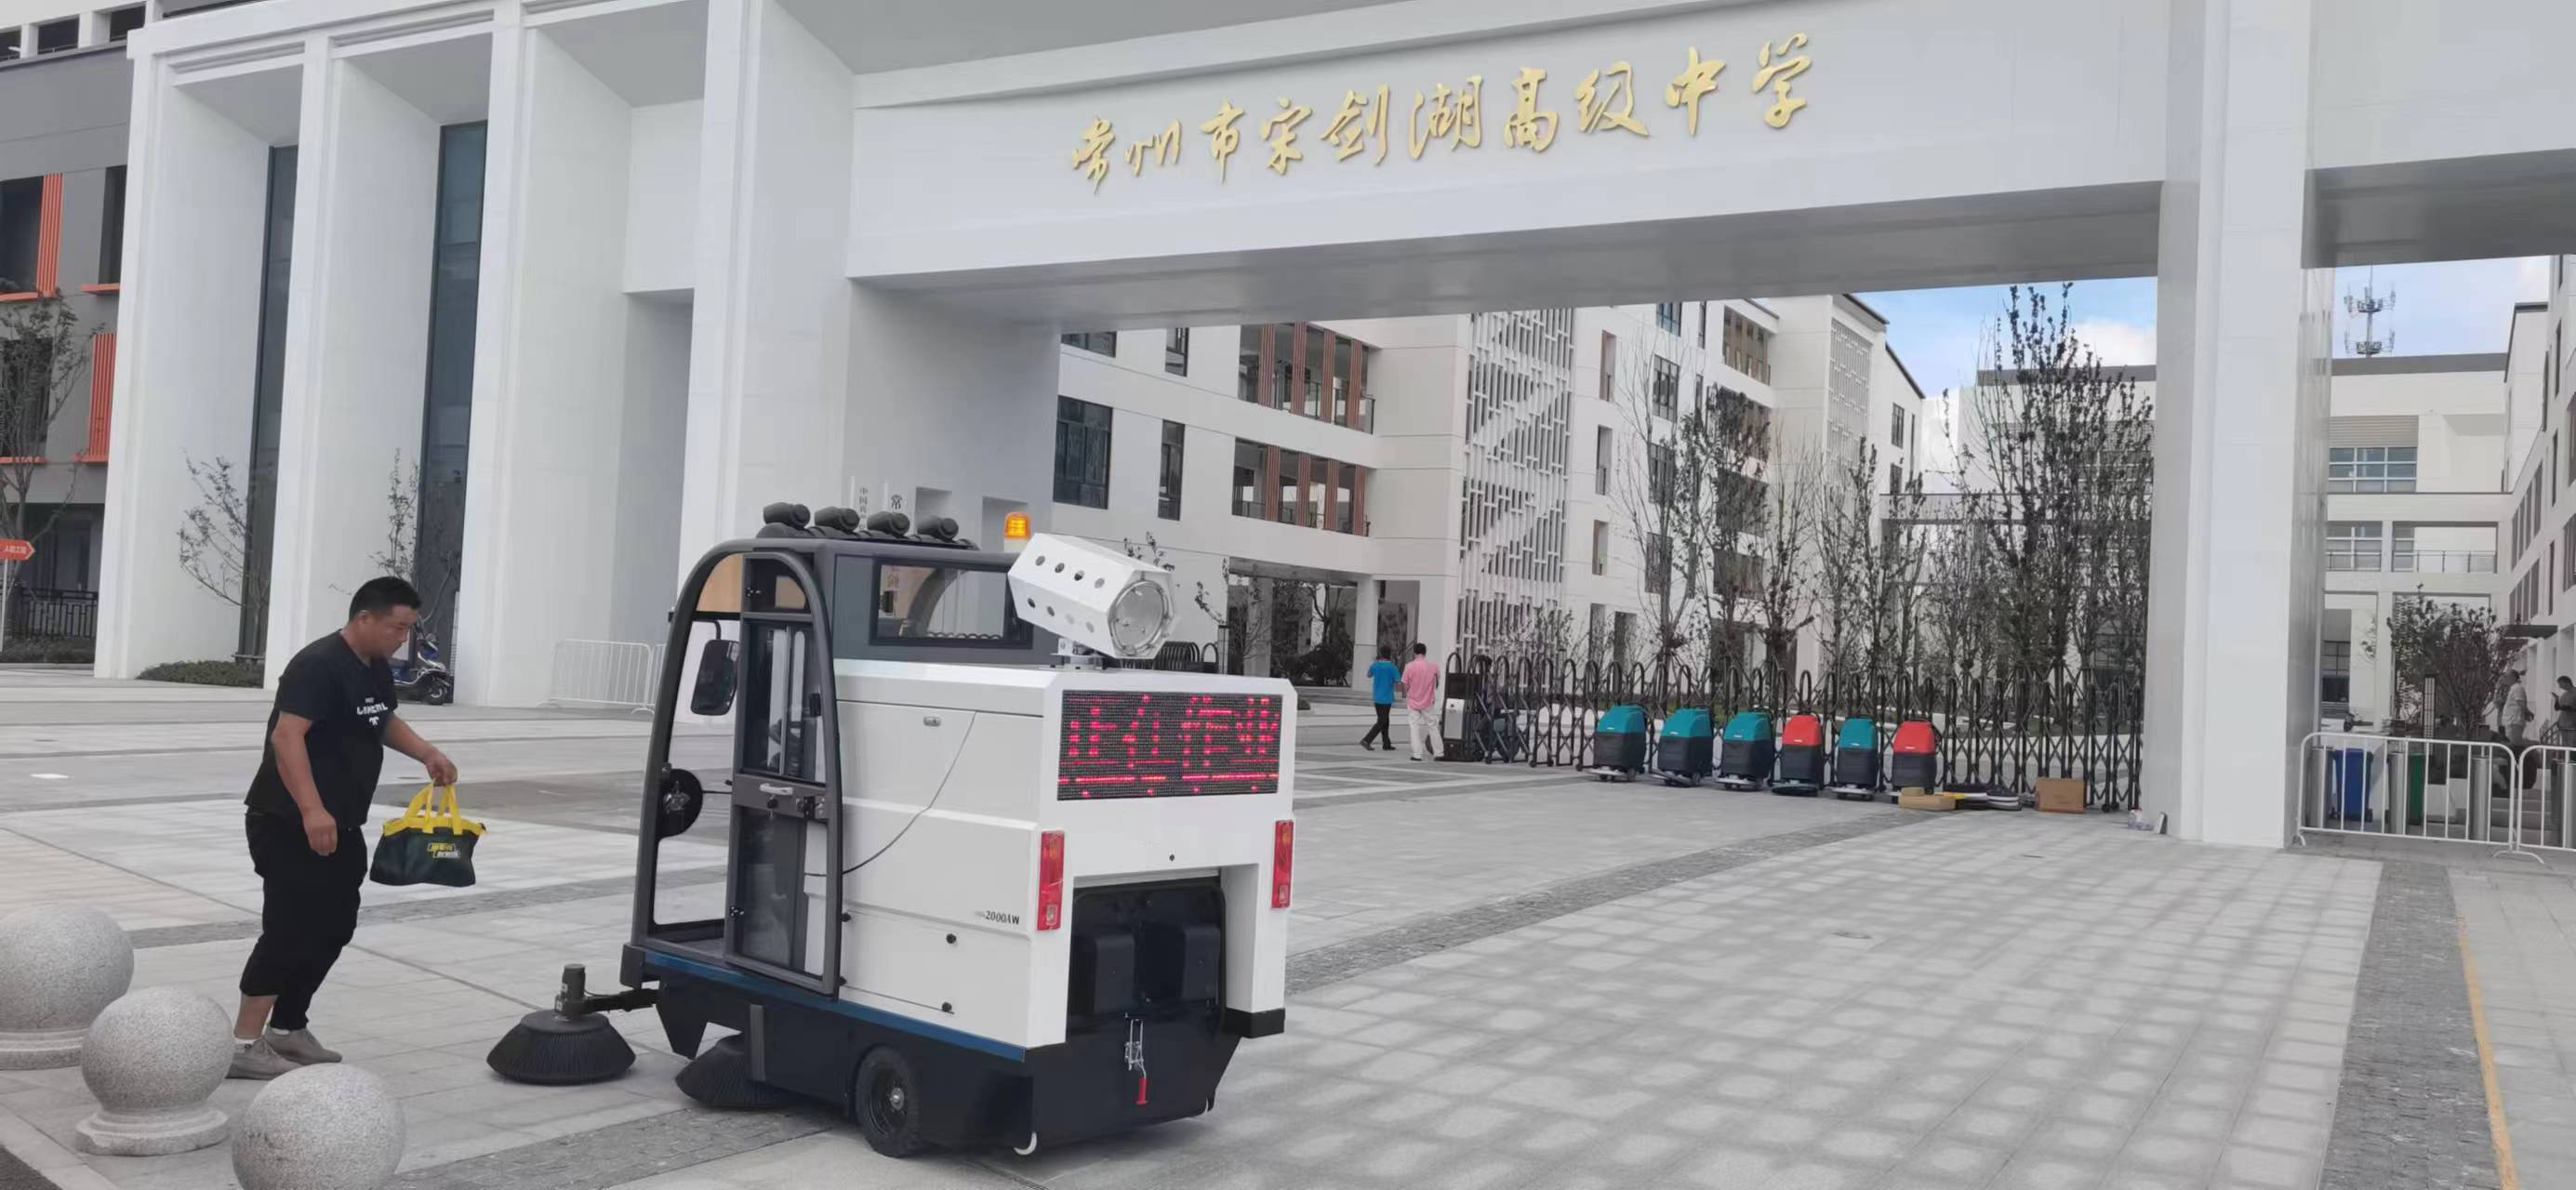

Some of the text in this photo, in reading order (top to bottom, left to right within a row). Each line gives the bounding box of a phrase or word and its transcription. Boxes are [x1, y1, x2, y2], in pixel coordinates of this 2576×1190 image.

[1072, 33, 1812, 192] 常州市宋剑湖高级中学
